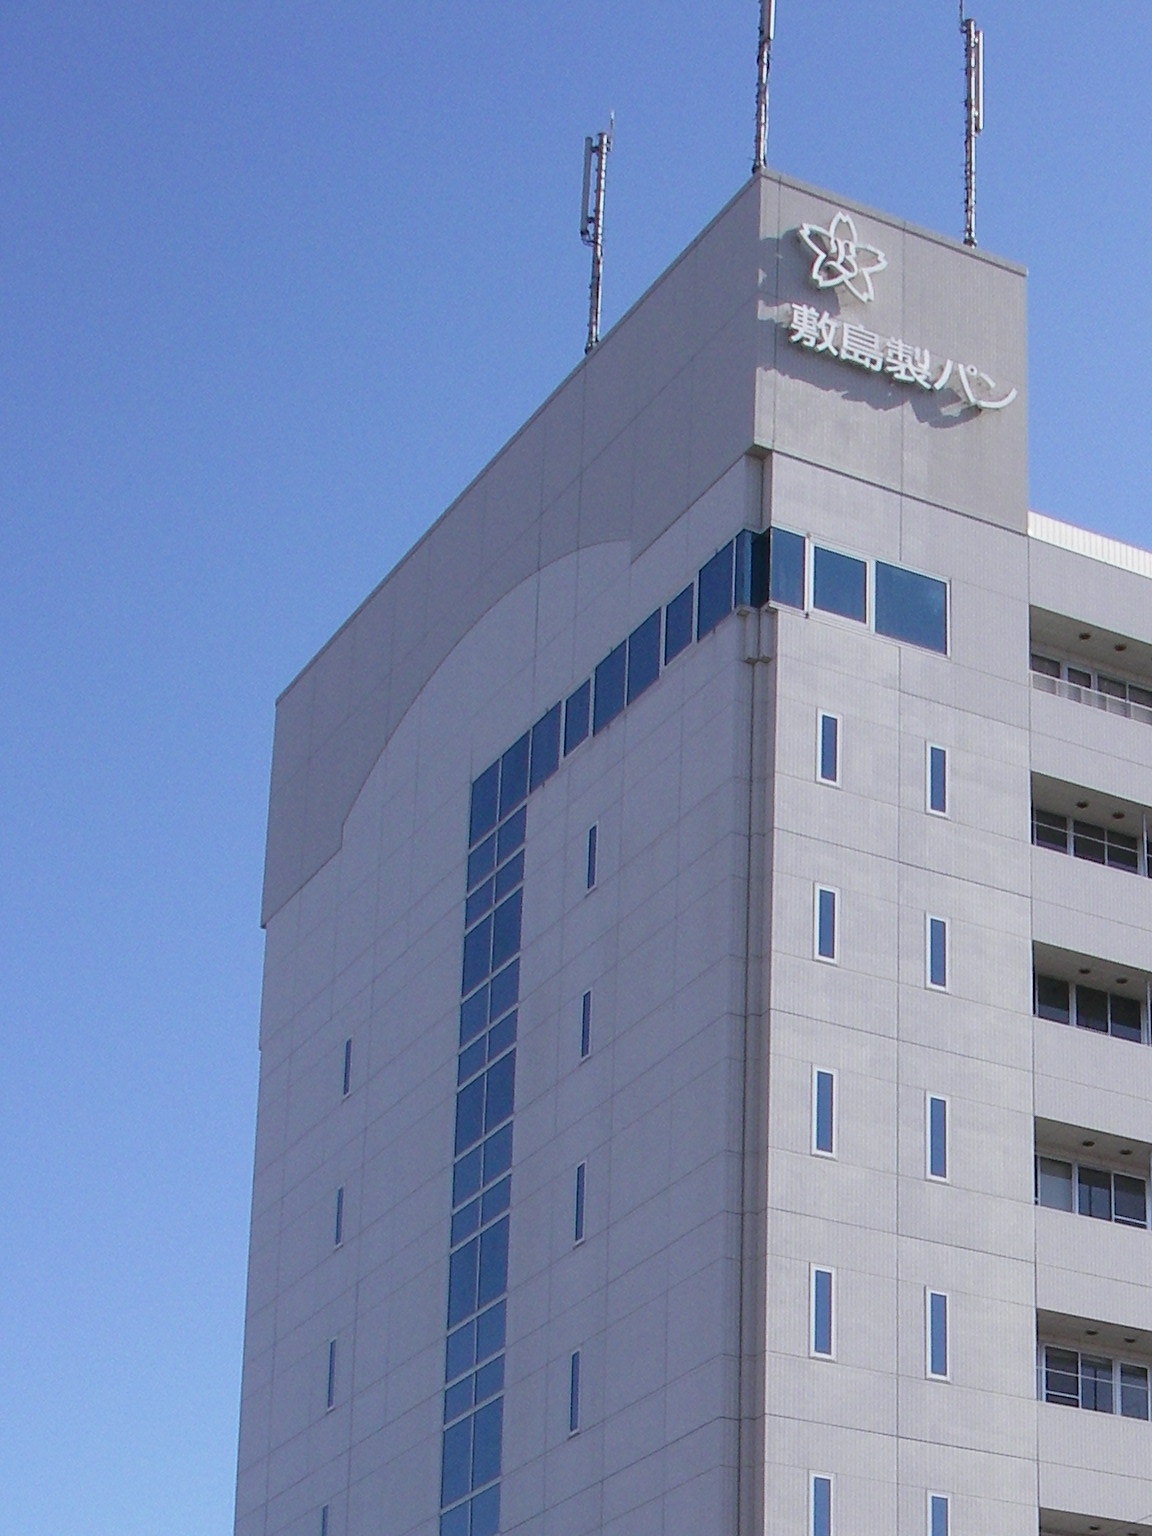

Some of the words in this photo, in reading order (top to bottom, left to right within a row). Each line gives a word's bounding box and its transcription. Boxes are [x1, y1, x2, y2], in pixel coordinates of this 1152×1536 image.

[788, 303, 1017, 409] 敷島製パン
